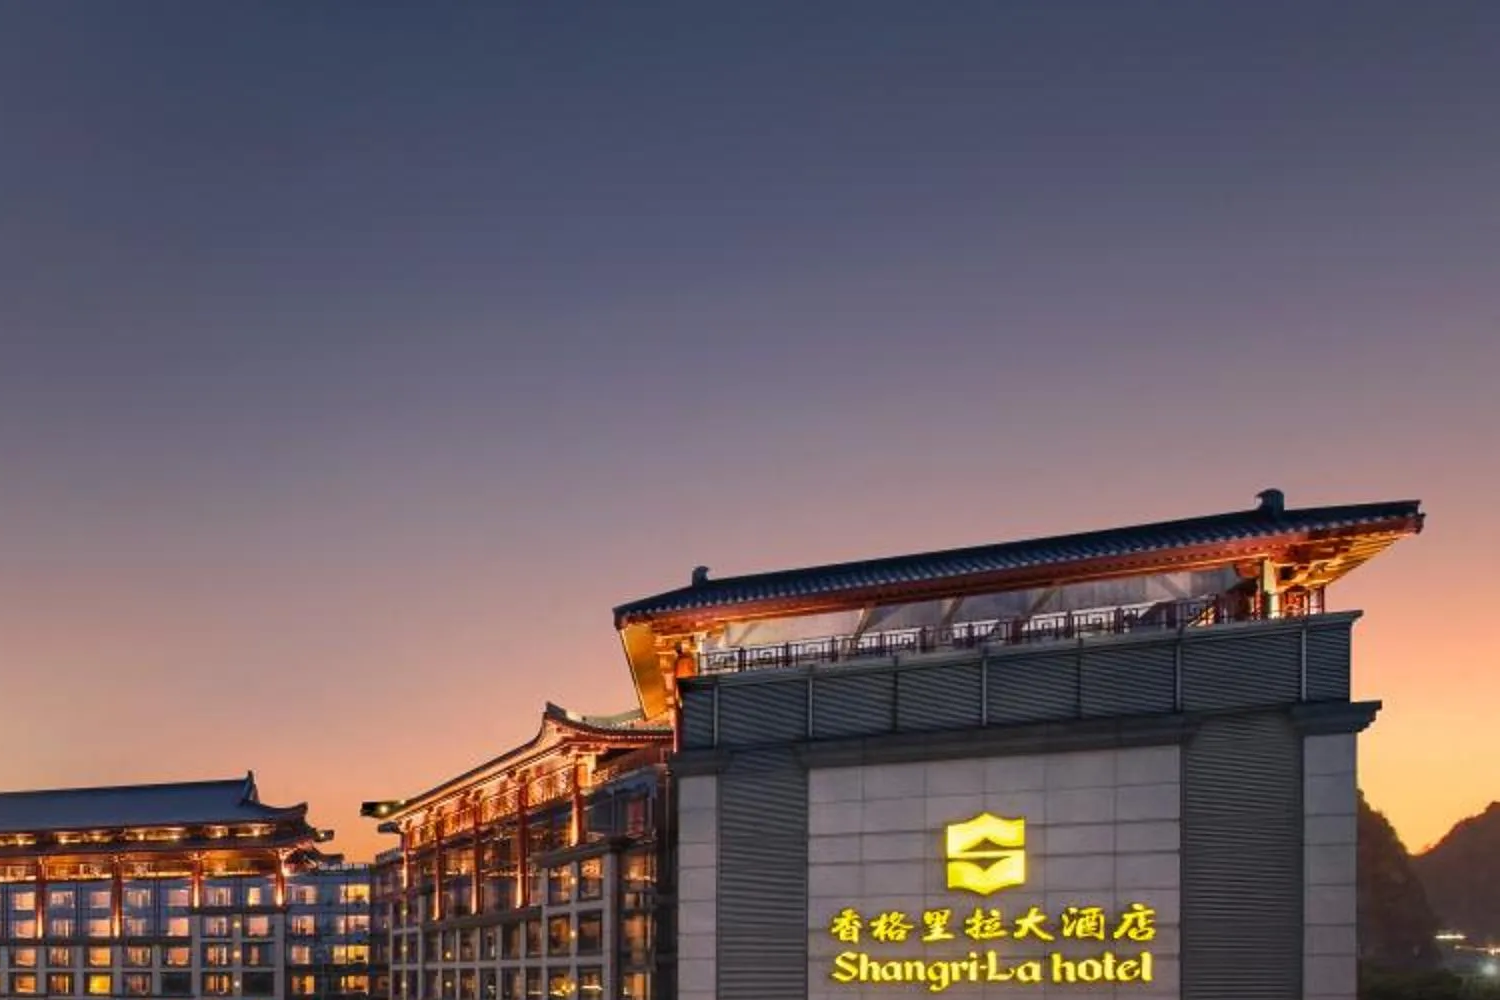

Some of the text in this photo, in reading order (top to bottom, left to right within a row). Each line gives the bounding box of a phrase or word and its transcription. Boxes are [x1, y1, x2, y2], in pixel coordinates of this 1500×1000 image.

[831, 904, 1156, 943] 香格里拉大酒店
[832, 950, 1153, 991] Shangri-La hotel
